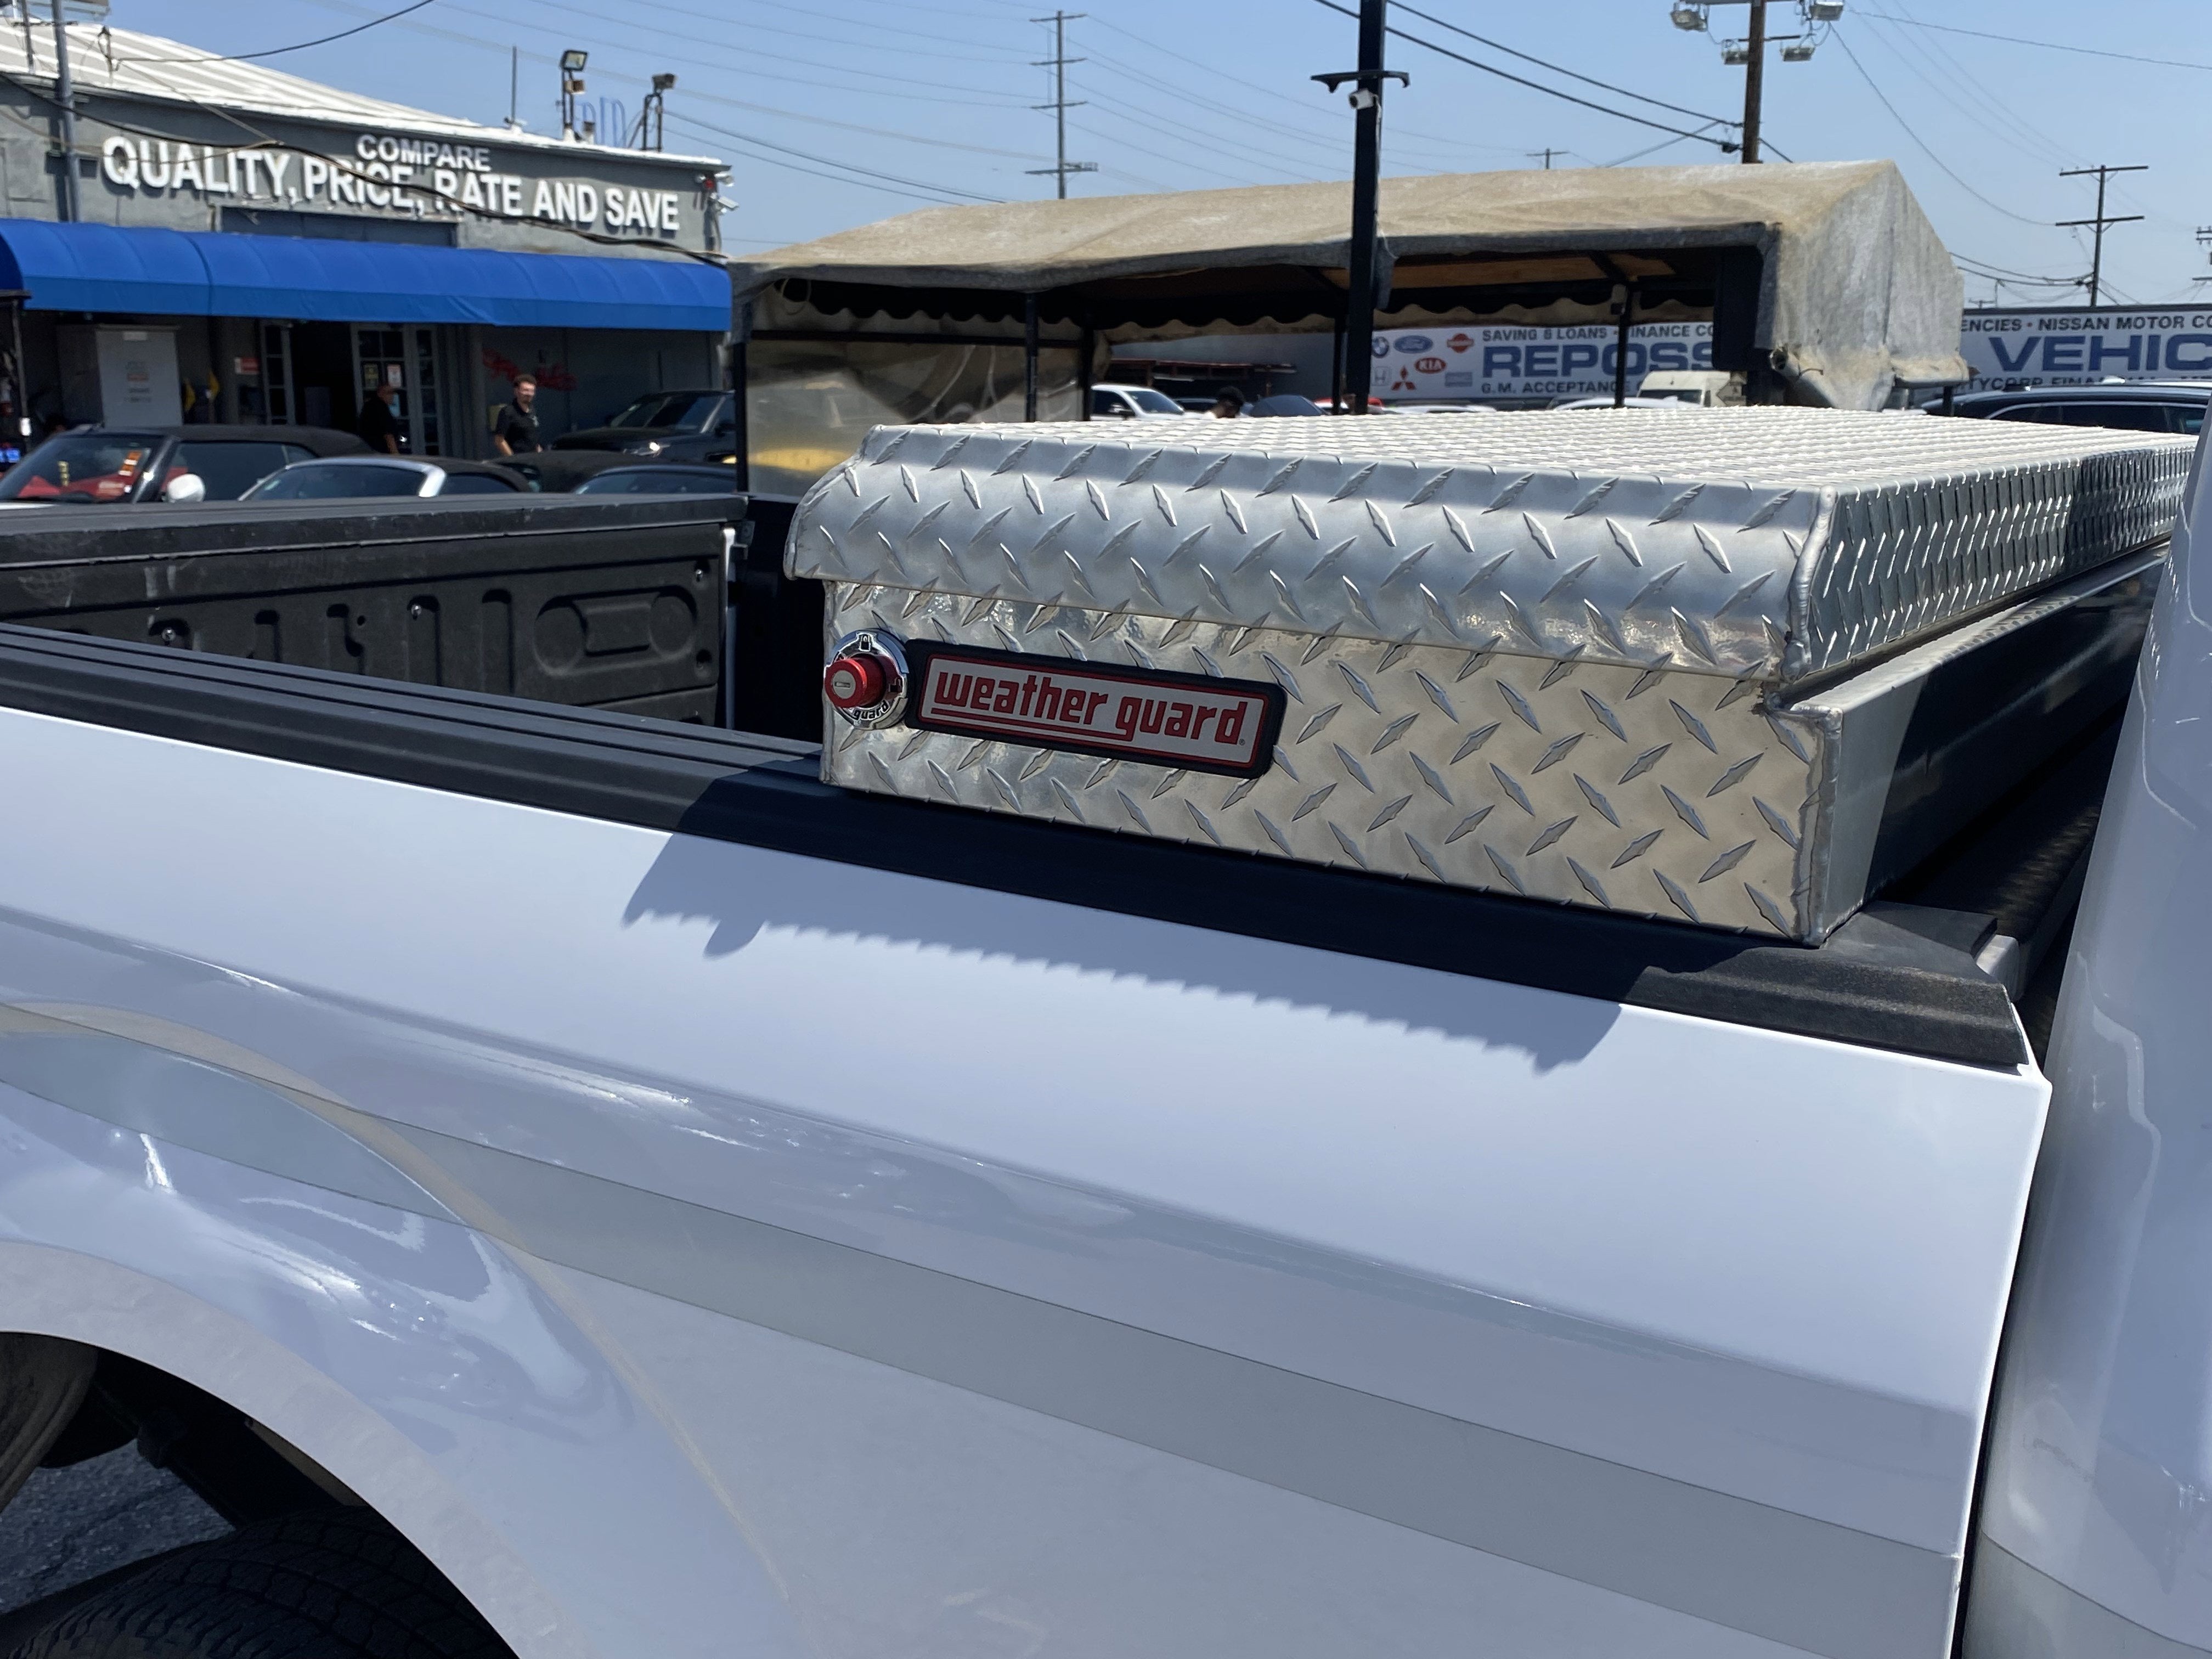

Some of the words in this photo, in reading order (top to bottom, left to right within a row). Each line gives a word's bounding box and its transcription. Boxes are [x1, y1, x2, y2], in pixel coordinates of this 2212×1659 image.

[357, 134, 491, 172] COMPARE
[103, 136, 298, 205] QUALITY,
[434, 168, 523, 216] RATE
[533, 179, 598, 223] AND
[605, 187, 680, 230] SAVE
[1482, 329, 1537, 342] SAVING
[1556, 327, 1607, 339] LOANS
[1629, 324, 1690, 337] INANCE
[2039, 317, 2109, 331] NISSAN
[2116, 315, 2185, 329] MOTOR
[1419, 359, 1442, 370] KIA
[852, 699, 890, 721] guard
[934, 670, 1109, 726] weather
[1115, 696, 1249, 745] guard
